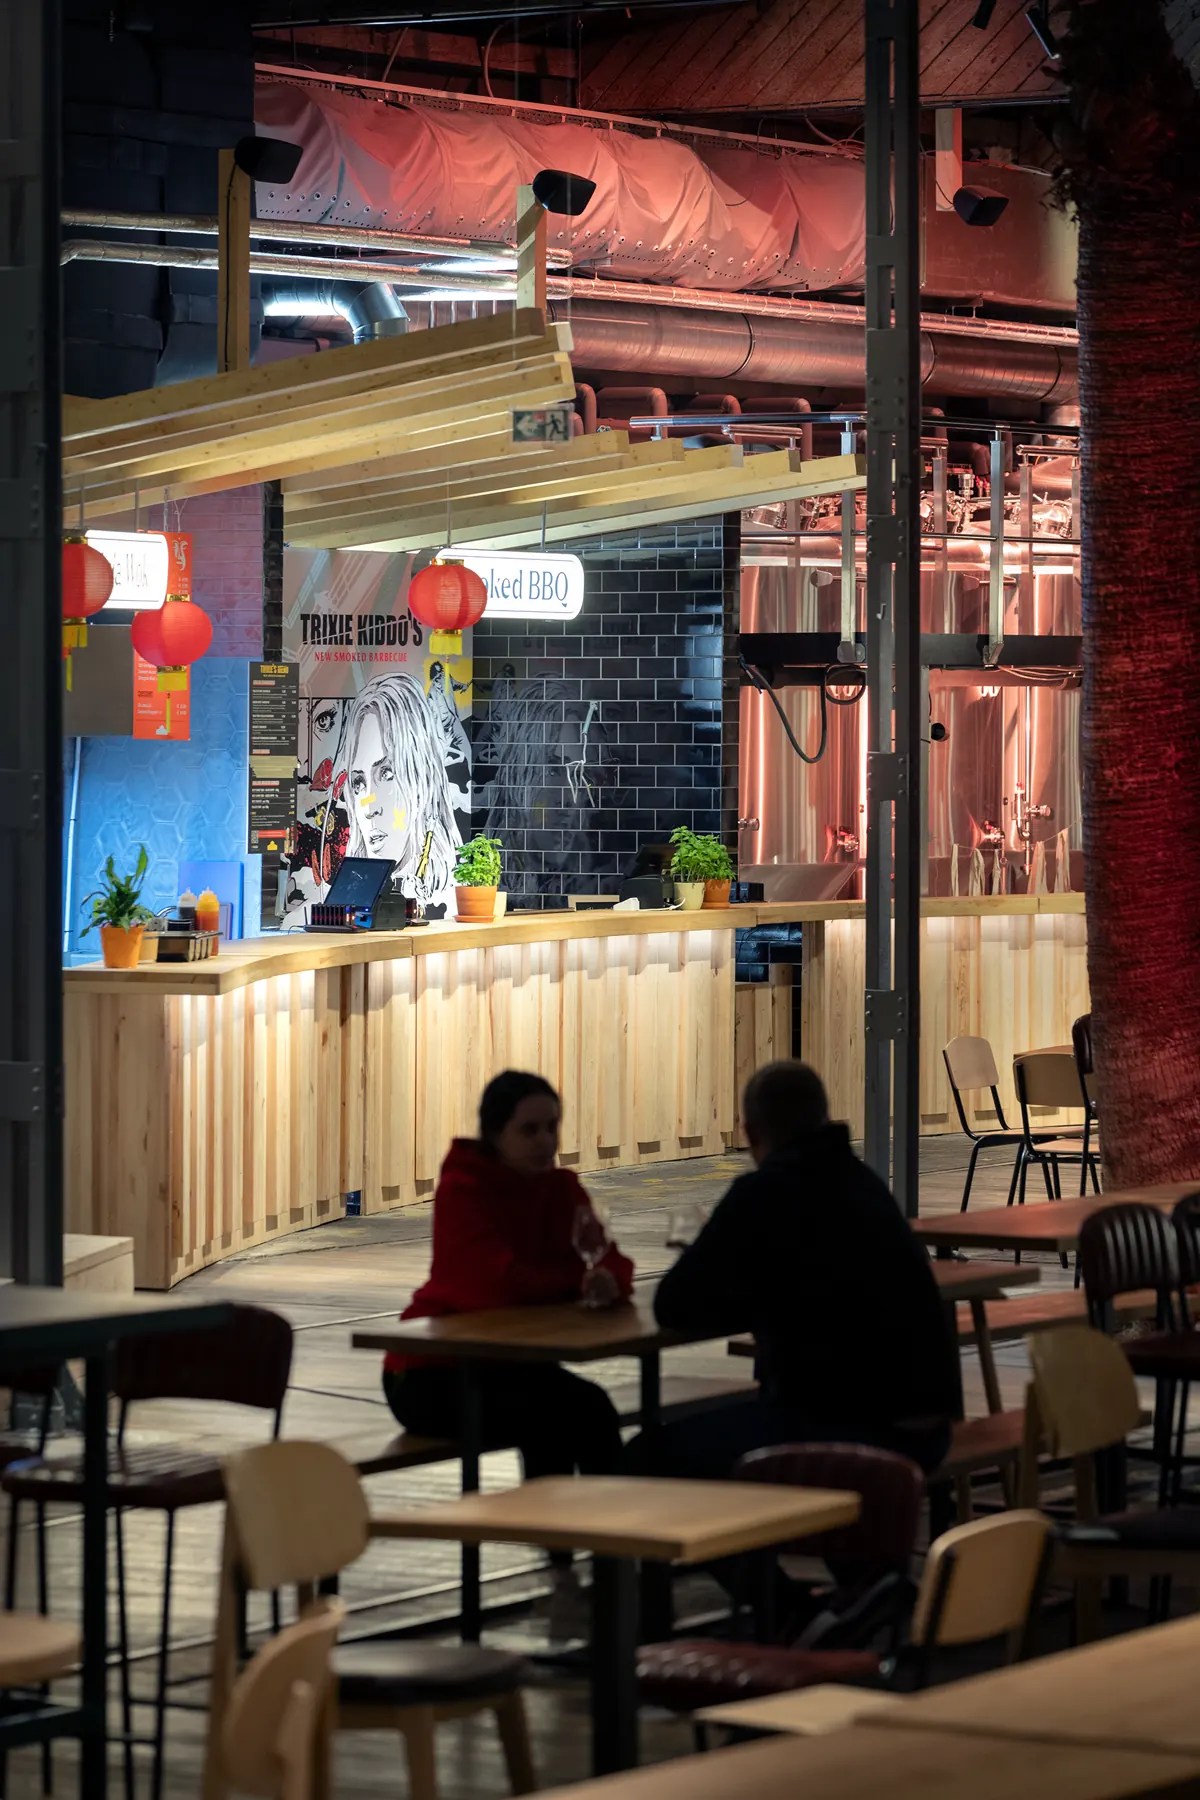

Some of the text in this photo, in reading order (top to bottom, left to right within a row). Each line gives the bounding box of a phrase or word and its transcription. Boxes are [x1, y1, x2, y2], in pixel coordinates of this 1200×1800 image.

[528, 570, 569, 608] BBQ
[300, 607, 423, 647] TRIXIE KIDDO'S
[314, 651, 407, 663] NEW SMOKED BARBECUE
